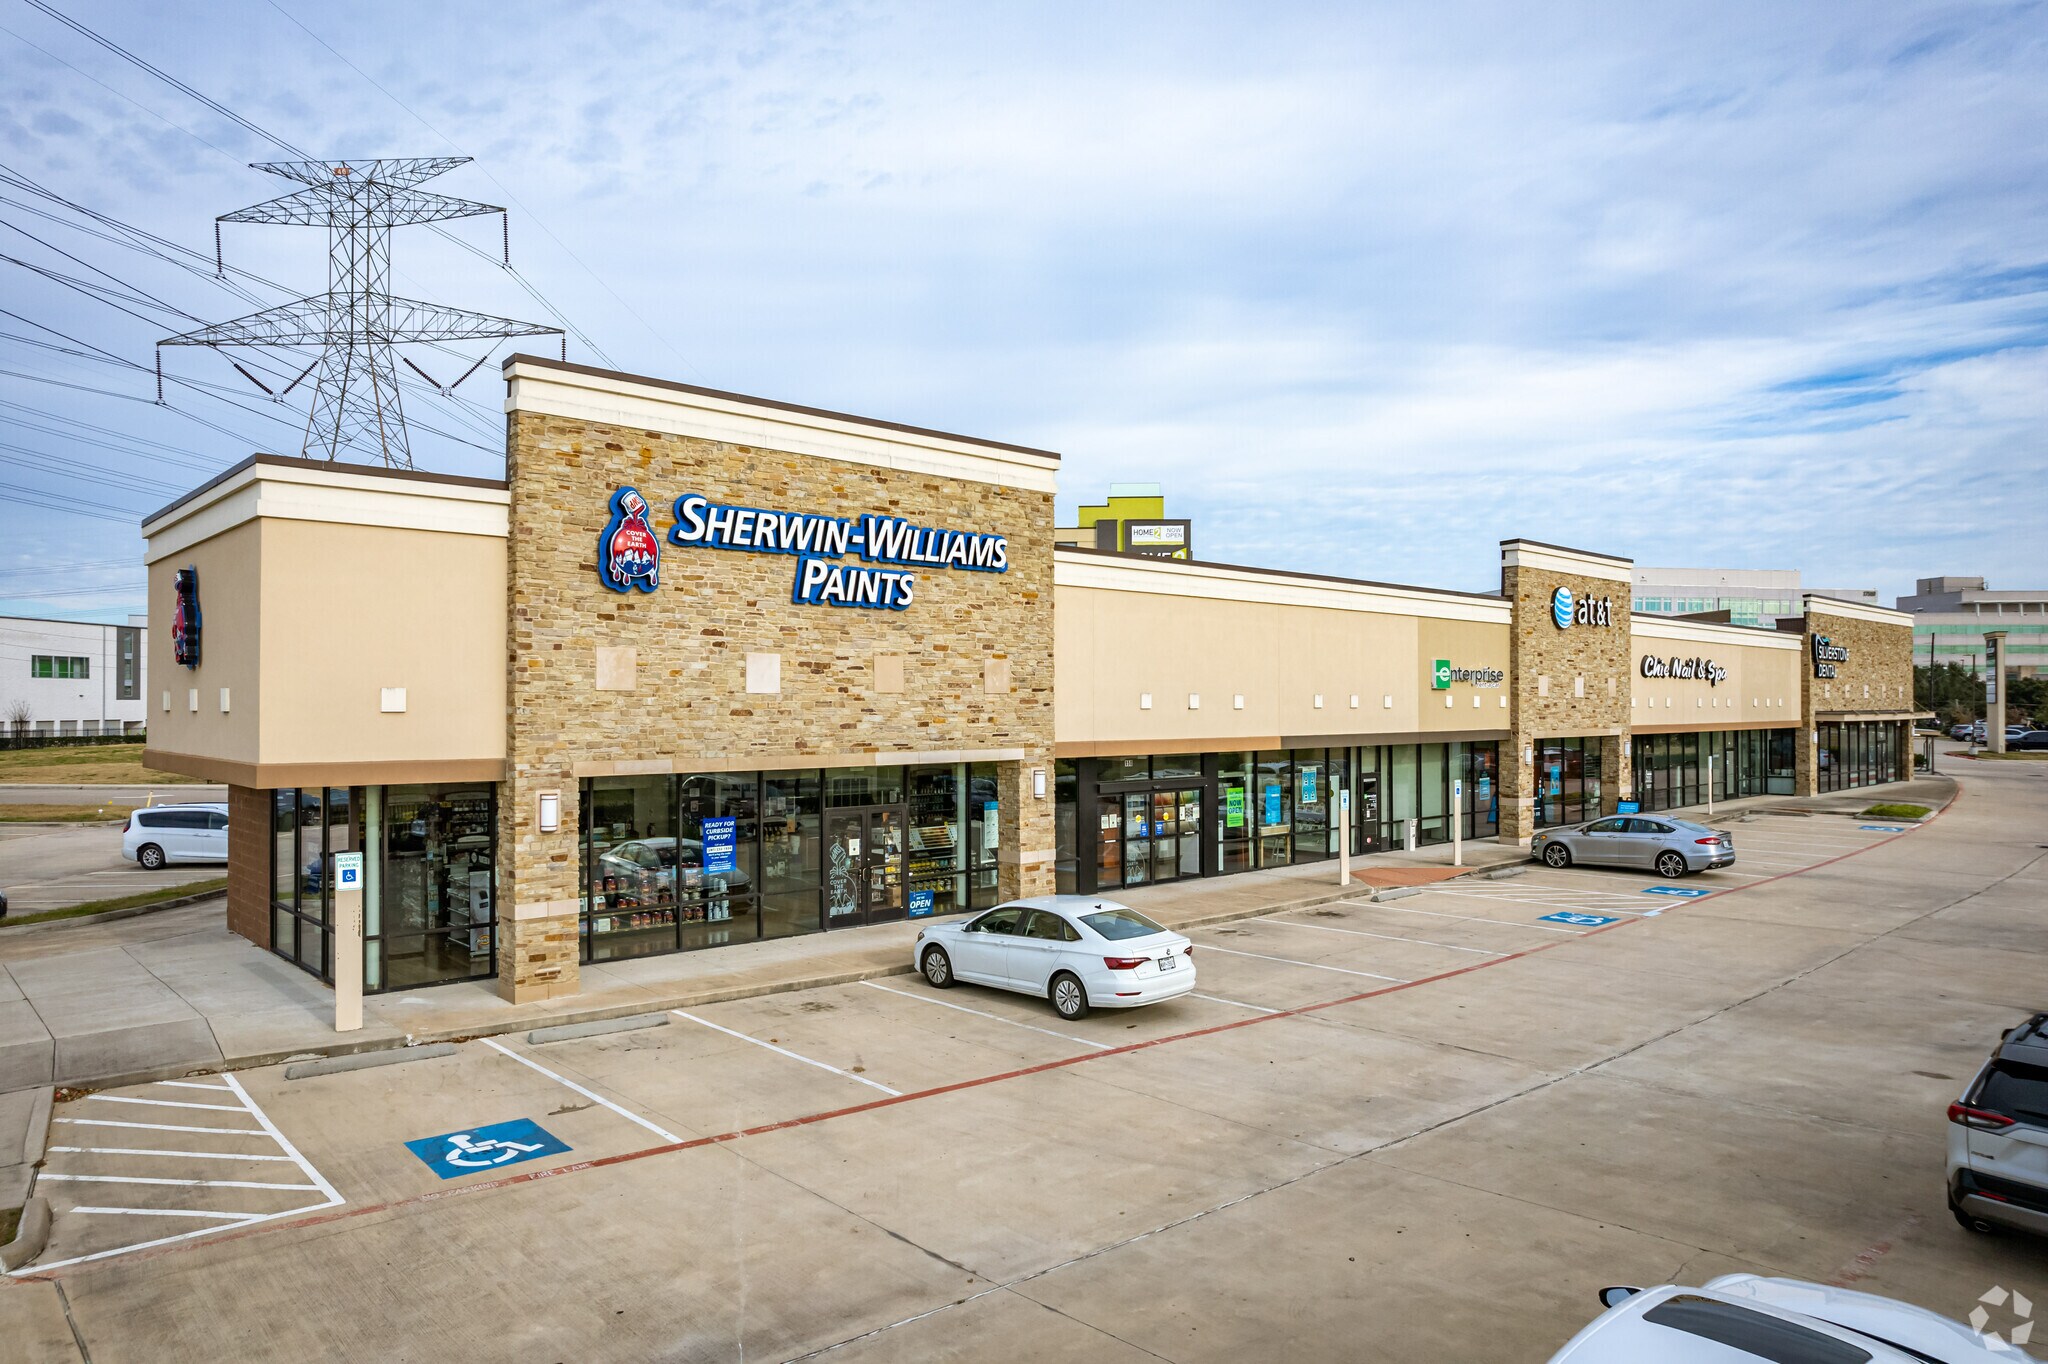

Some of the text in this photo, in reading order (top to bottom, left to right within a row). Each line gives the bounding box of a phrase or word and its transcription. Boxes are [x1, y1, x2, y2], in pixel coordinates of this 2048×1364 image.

[625, 530, 647, 538] COVER
[677, 497, 1009, 568] SHERWIN-WILLIAMS
[627, 541, 647, 549] EARTH
[801, 558, 915, 606] PAINTS
[1577, 593, 1613, 627] at&t
[1643, 655, 1728, 685] Chic Nail & Spa
[1438, 666, 1504, 686] enterprise
[1228, 806, 1243, 815] OPEN
[705, 827, 734, 835] CURBSIDE
[829, 878, 847, 886] COVER
[909, 899, 932, 909] OPEN
[528, 1170, 557, 1181] FIRE
